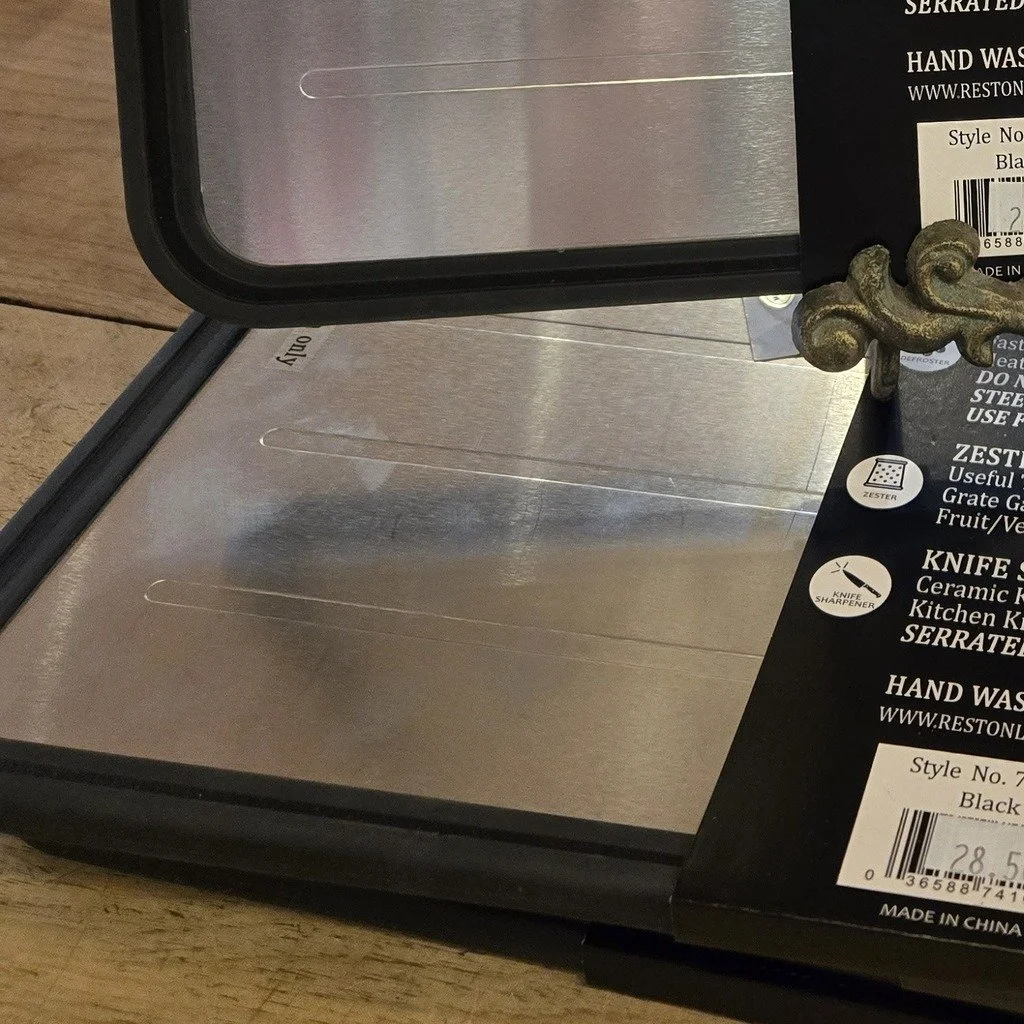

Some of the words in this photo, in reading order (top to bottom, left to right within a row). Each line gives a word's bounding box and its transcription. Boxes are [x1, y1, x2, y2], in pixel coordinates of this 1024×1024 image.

[906, 48, 973, 73] HAND
[949, 129, 991, 147] Style
[276, 336, 312, 366] only
[975, 369, 1010, 386] DO
[966, 406, 1011, 426] USE
[948, 465, 1015, 489] Useful
[862, 492, 897, 502] ZESTER
[942, 486, 1000, 509] Grate
[921, 549, 1012, 580] KNIFE
[834, 590, 861, 601] KNIFE
[916, 575, 1010, 603] Ceramic
[815, 595, 875, 609] SHARPENER
[908, 598, 996, 627] Kitchen
[884, 674, 964, 703] HAND
[909, 755, 962, 780] Style
[973, 764, 1006, 785] No.
[959, 792, 1021, 816] Black
[879, 903, 936, 924] MADE
[939, 912, 960, 927] IN
[963, 916, 1023, 937] CHINA
